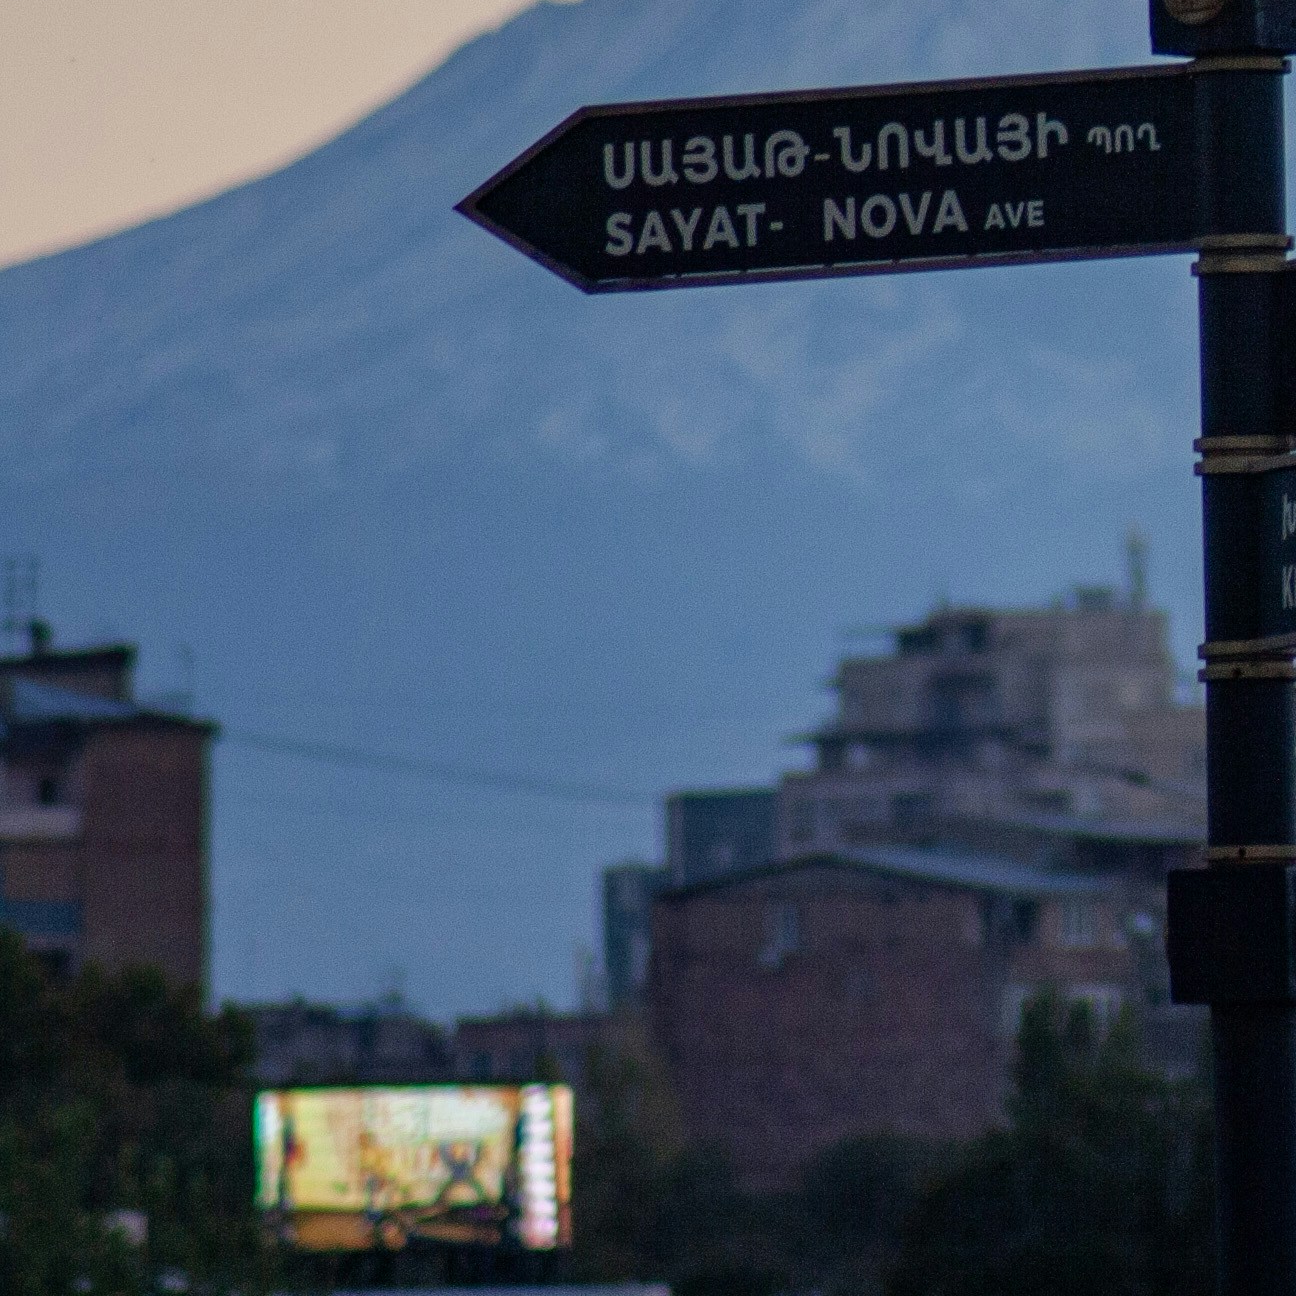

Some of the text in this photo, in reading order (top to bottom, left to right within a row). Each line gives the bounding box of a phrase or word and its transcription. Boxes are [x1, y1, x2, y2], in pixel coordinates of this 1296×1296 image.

[603, 111, 1069, 189] ՍԱՅԱԹ-ՆՈՎԱՅԻ
[606, 190, 1044, 256] SAYAT- NOVA AVE
